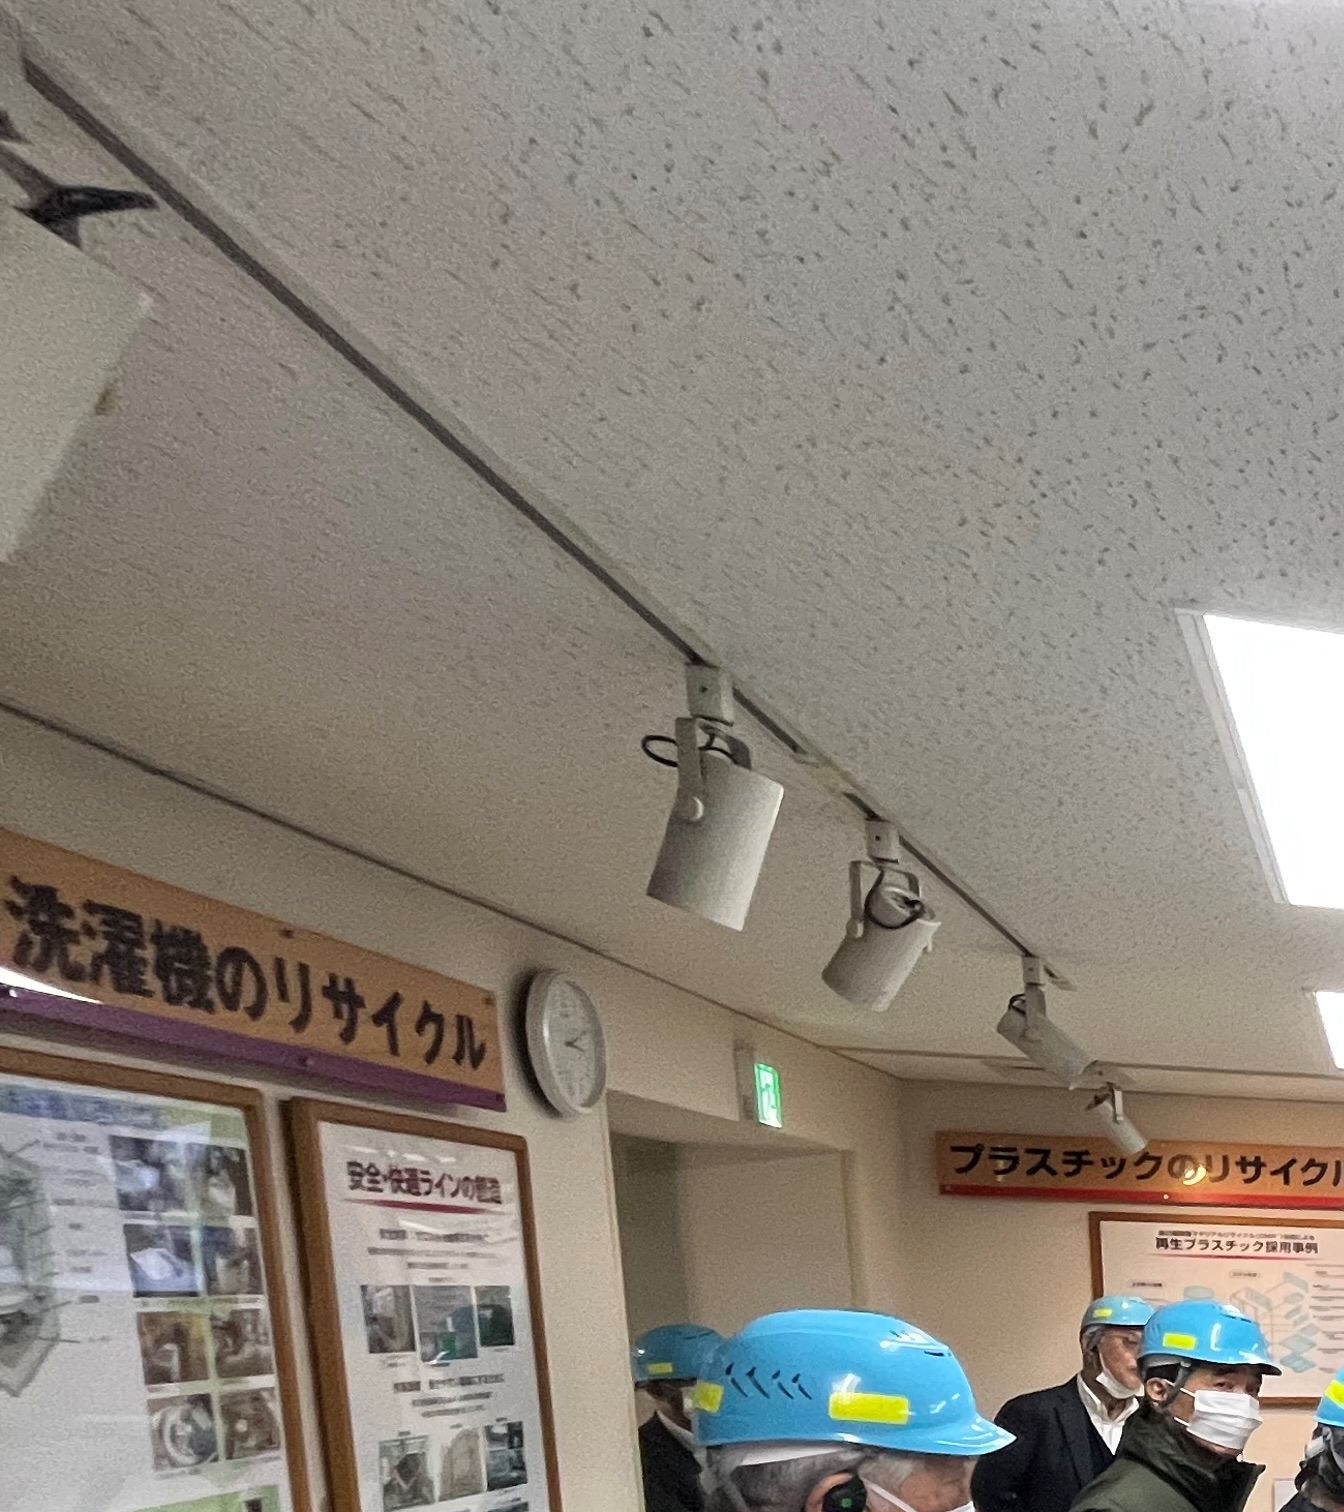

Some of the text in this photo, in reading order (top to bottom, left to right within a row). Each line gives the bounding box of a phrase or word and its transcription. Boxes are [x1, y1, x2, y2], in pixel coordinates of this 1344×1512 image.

[5, 875, 487, 1071] 洗濯機のリサイクル
[1155, 1236, 1319, 1254] 再生プラスチック採用事例
